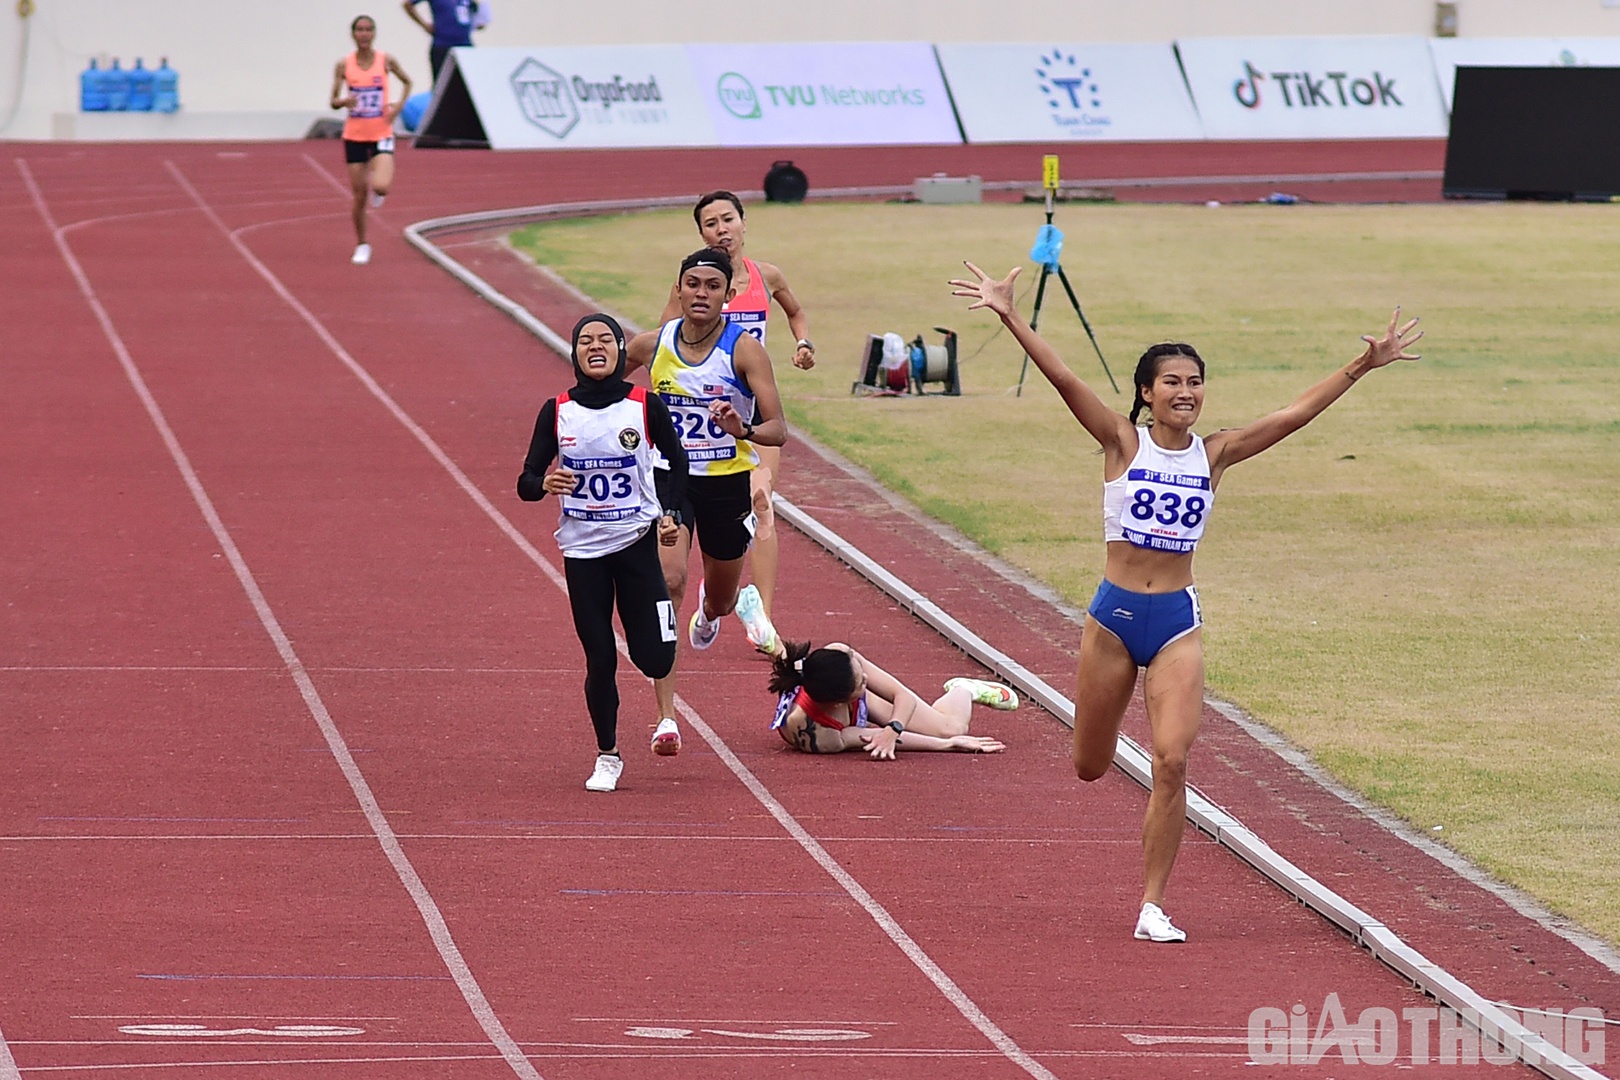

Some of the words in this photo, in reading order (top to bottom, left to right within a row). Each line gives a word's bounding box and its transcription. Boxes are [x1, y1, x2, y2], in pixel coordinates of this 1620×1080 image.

[764, 85, 816, 106] TVU
[820, 84, 925, 106] Networks
[1271, 72, 1403, 107] TikTok
[682, 397, 695, 406] SEA
[584, 460, 598, 469] SEA
[599, 460, 623, 468] Games
[571, 472, 632, 501] 203
[1160, 474, 1175, 484] SEA
[1176, 475, 1202, 487] Games
[1131, 488, 1205, 529] 838
[1150, 527, 1178, 536] VIETNAM
[1151, 536, 1181, 551] VIETNAM
